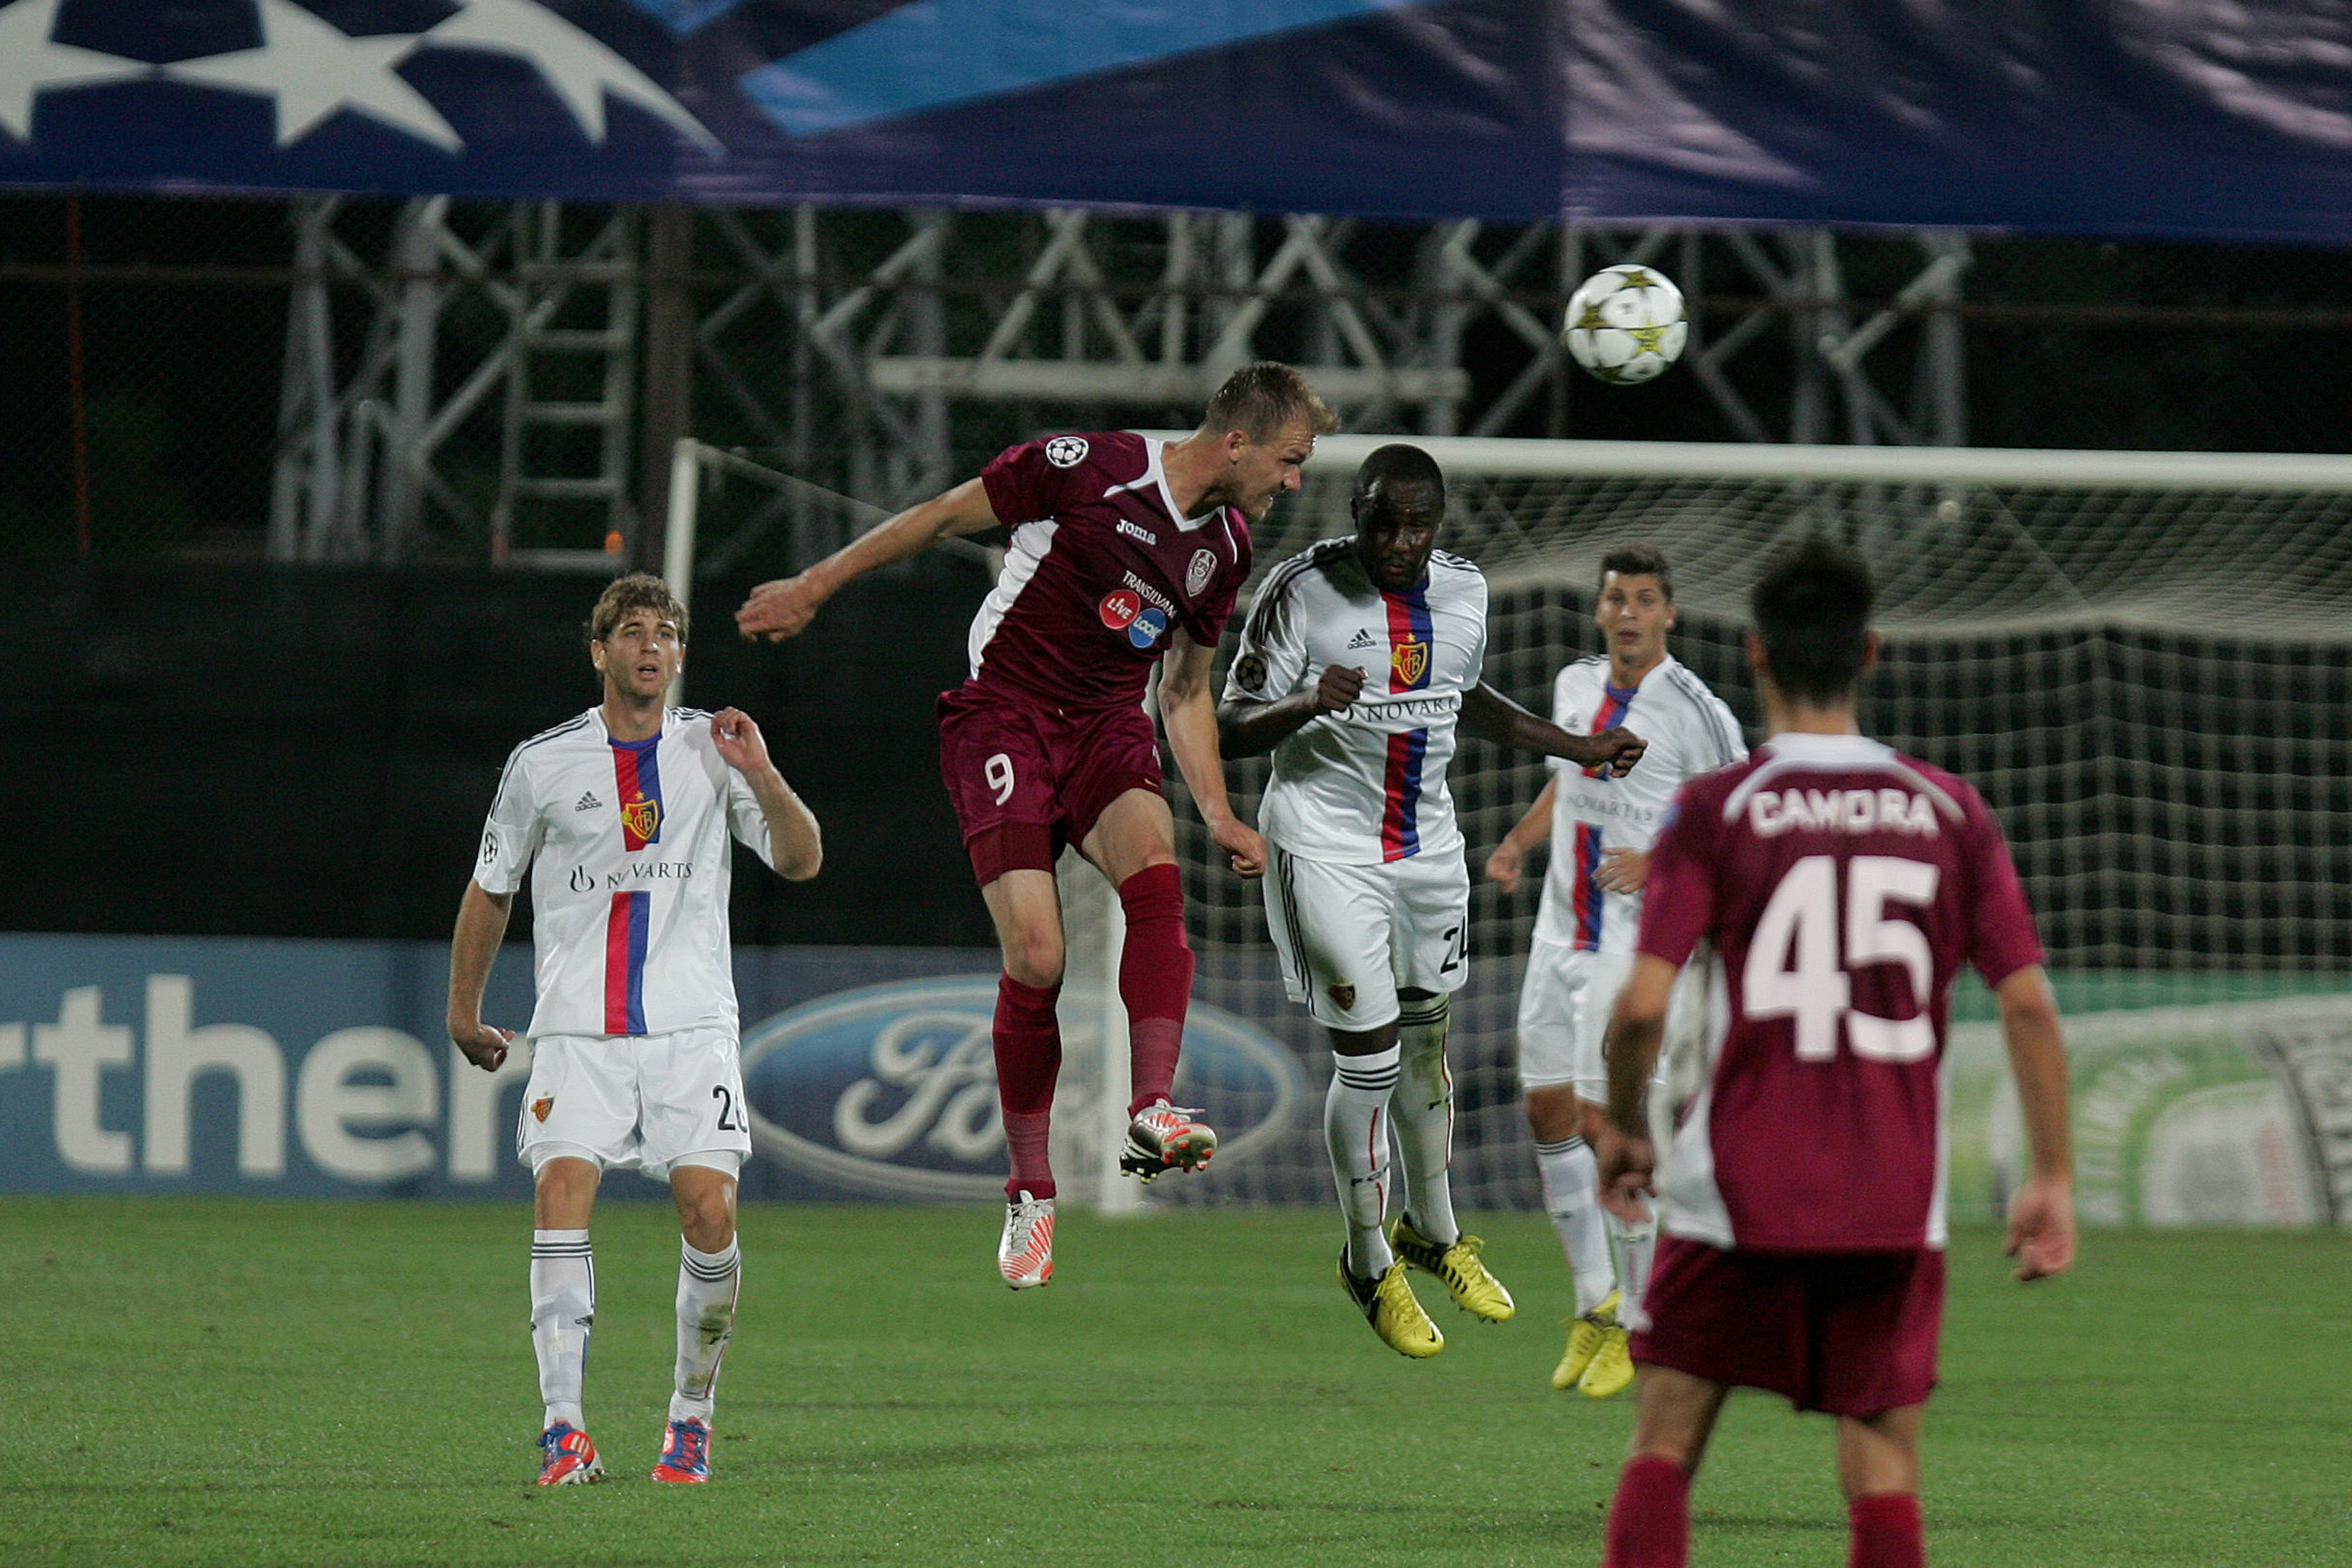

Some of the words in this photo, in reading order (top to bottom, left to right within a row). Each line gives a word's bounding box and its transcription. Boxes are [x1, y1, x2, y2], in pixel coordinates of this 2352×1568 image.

[1116, 518, 1156, 545] Joma
[985, 753, 1014, 806] 9
[1747, 787, 1942, 840] CAMORA
[1741, 854, 1940, 1063] 45
